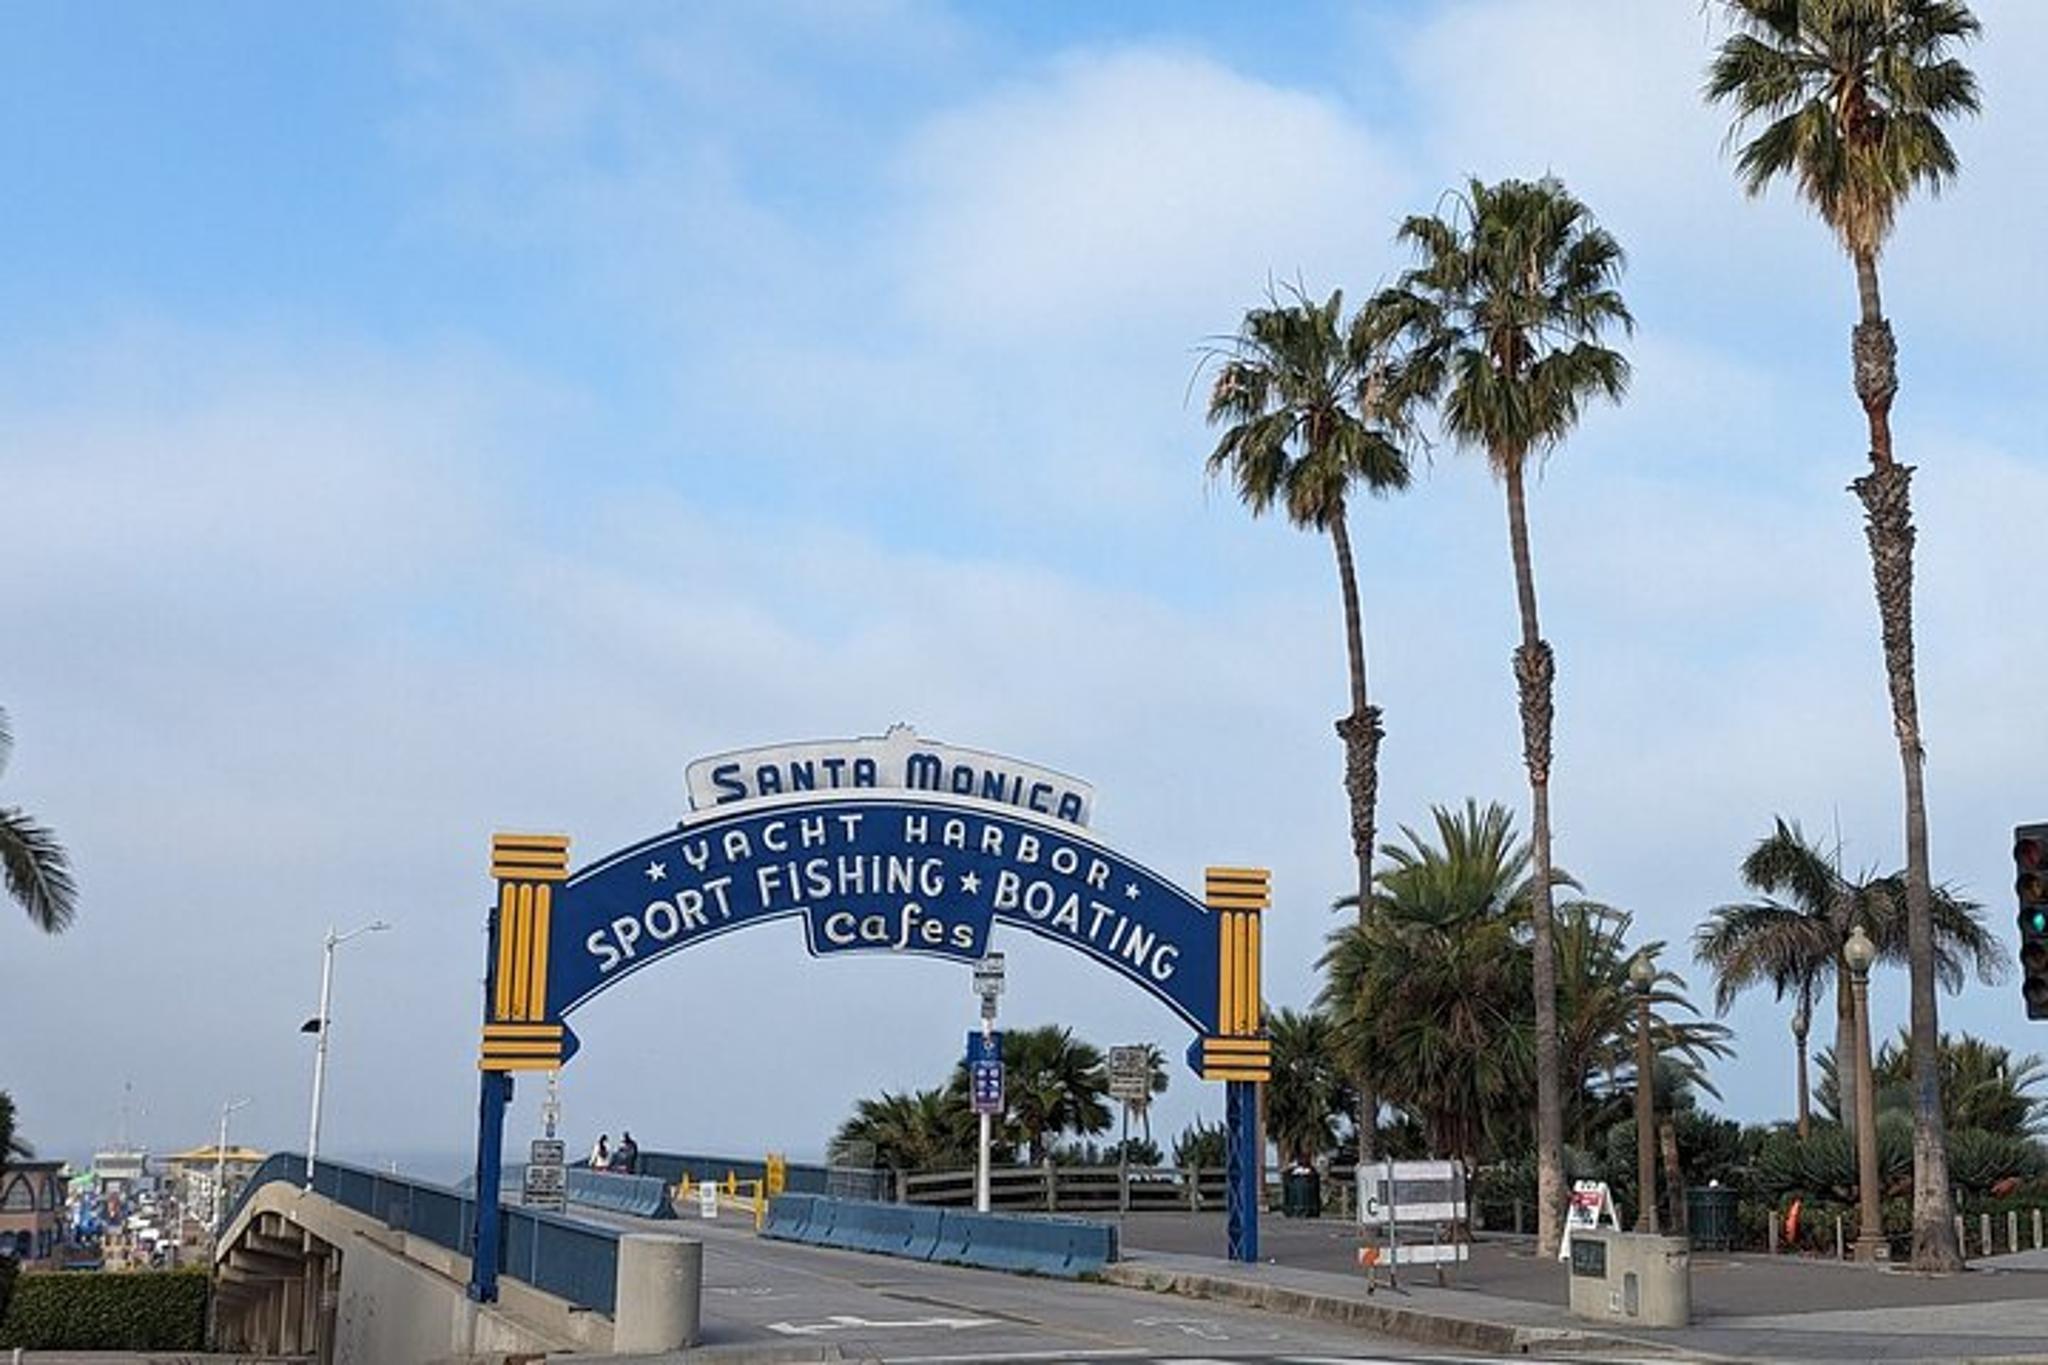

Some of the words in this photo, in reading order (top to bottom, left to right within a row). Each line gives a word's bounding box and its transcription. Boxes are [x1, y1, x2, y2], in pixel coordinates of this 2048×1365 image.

[711, 757, 878, 804] SANTA
[906, 752, 1084, 824] MONICA
[682, 814, 863, 872] YACHT
[905, 815, 1111, 890] HARBOR
[586, 876, 733, 974] SPORT
[756, 855, 944, 908] FISHING
[994, 870, 1179, 980] BOATING
